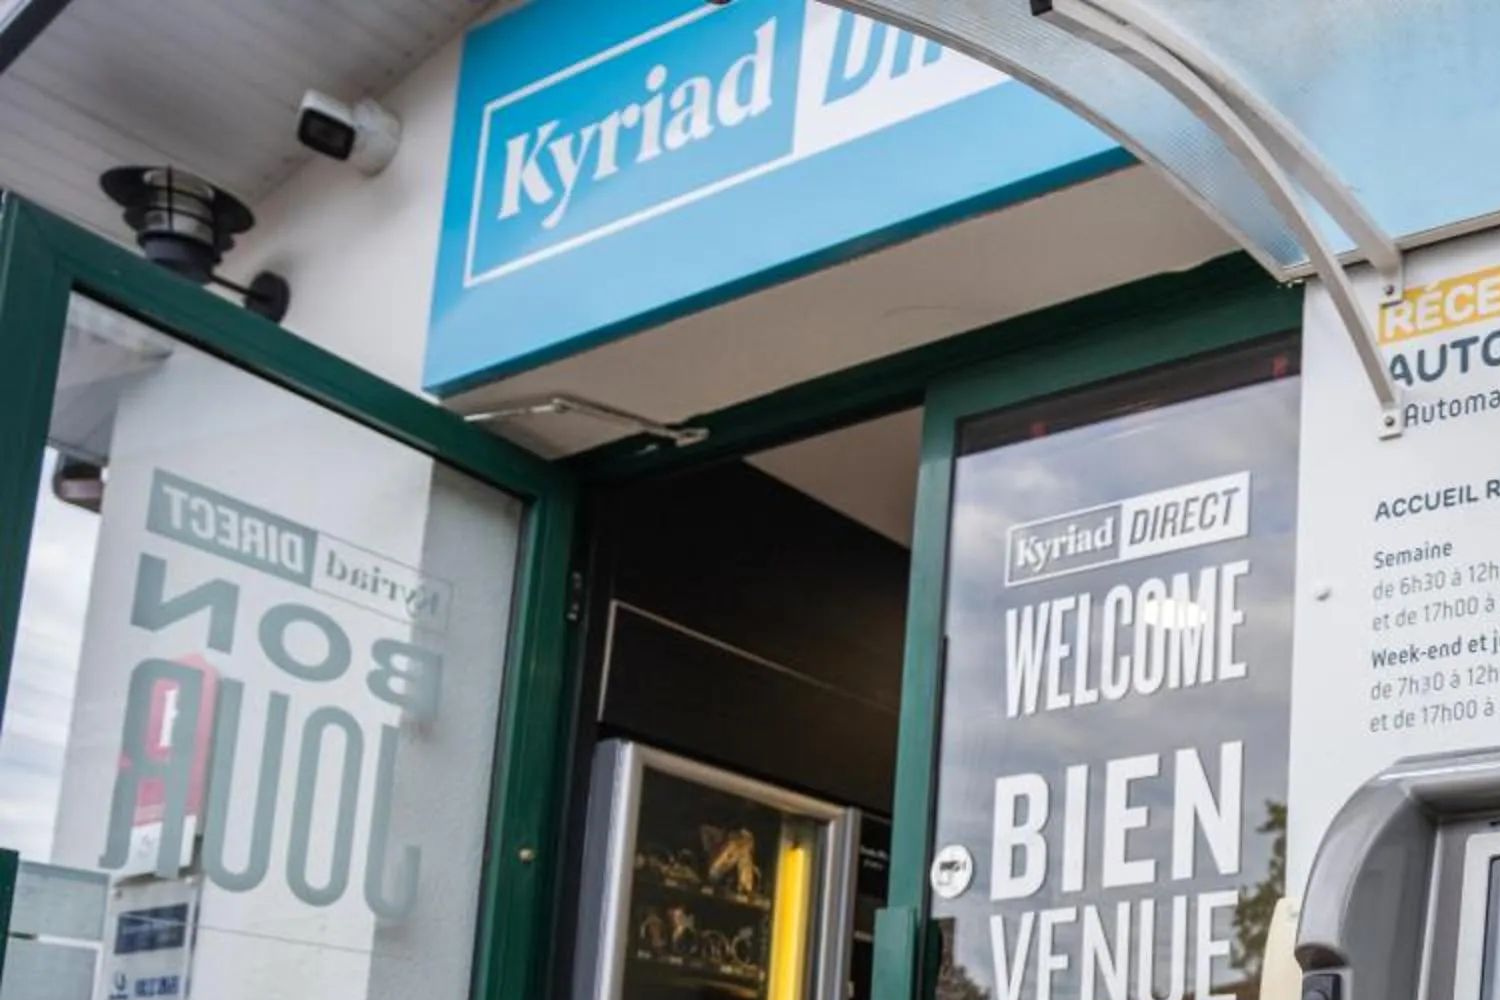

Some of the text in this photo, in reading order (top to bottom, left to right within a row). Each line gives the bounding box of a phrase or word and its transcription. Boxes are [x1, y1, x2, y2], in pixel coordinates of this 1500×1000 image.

[497, 16, 778, 229] Kyriad
[1374, 484, 1479, 522] ACCUEIL
[1015, 486, 1241, 572] Kyriad DIRECT
[1373, 541, 1453, 569] Semaine
[1372, 580, 1394, 601] de
[1399, 570, 1446, 595] 6h30
[1450, 570, 1462, 587] à
[1372, 615, 1390, 631] et
[1395, 609, 1417, 627] de
[1424, 596, 1479, 623] 17h00
[1484, 593, 1496, 612] à
[1006, 560, 1249, 718] WELCOME
[1371, 637, 1463, 669] Week-end
[1467, 635, 1487, 652] et
[1370, 682, 1392, 700] de
[1397, 671, 1444, 697] 7h30
[1449, 672, 1461, 689] à
[1369, 716, 1388, 733] et
[1393, 709, 1415, 729] de
[1421, 699, 1477, 725] 17h00
[1483, 699, 1495, 717] à
[990, 740, 1243, 901] BIEN
